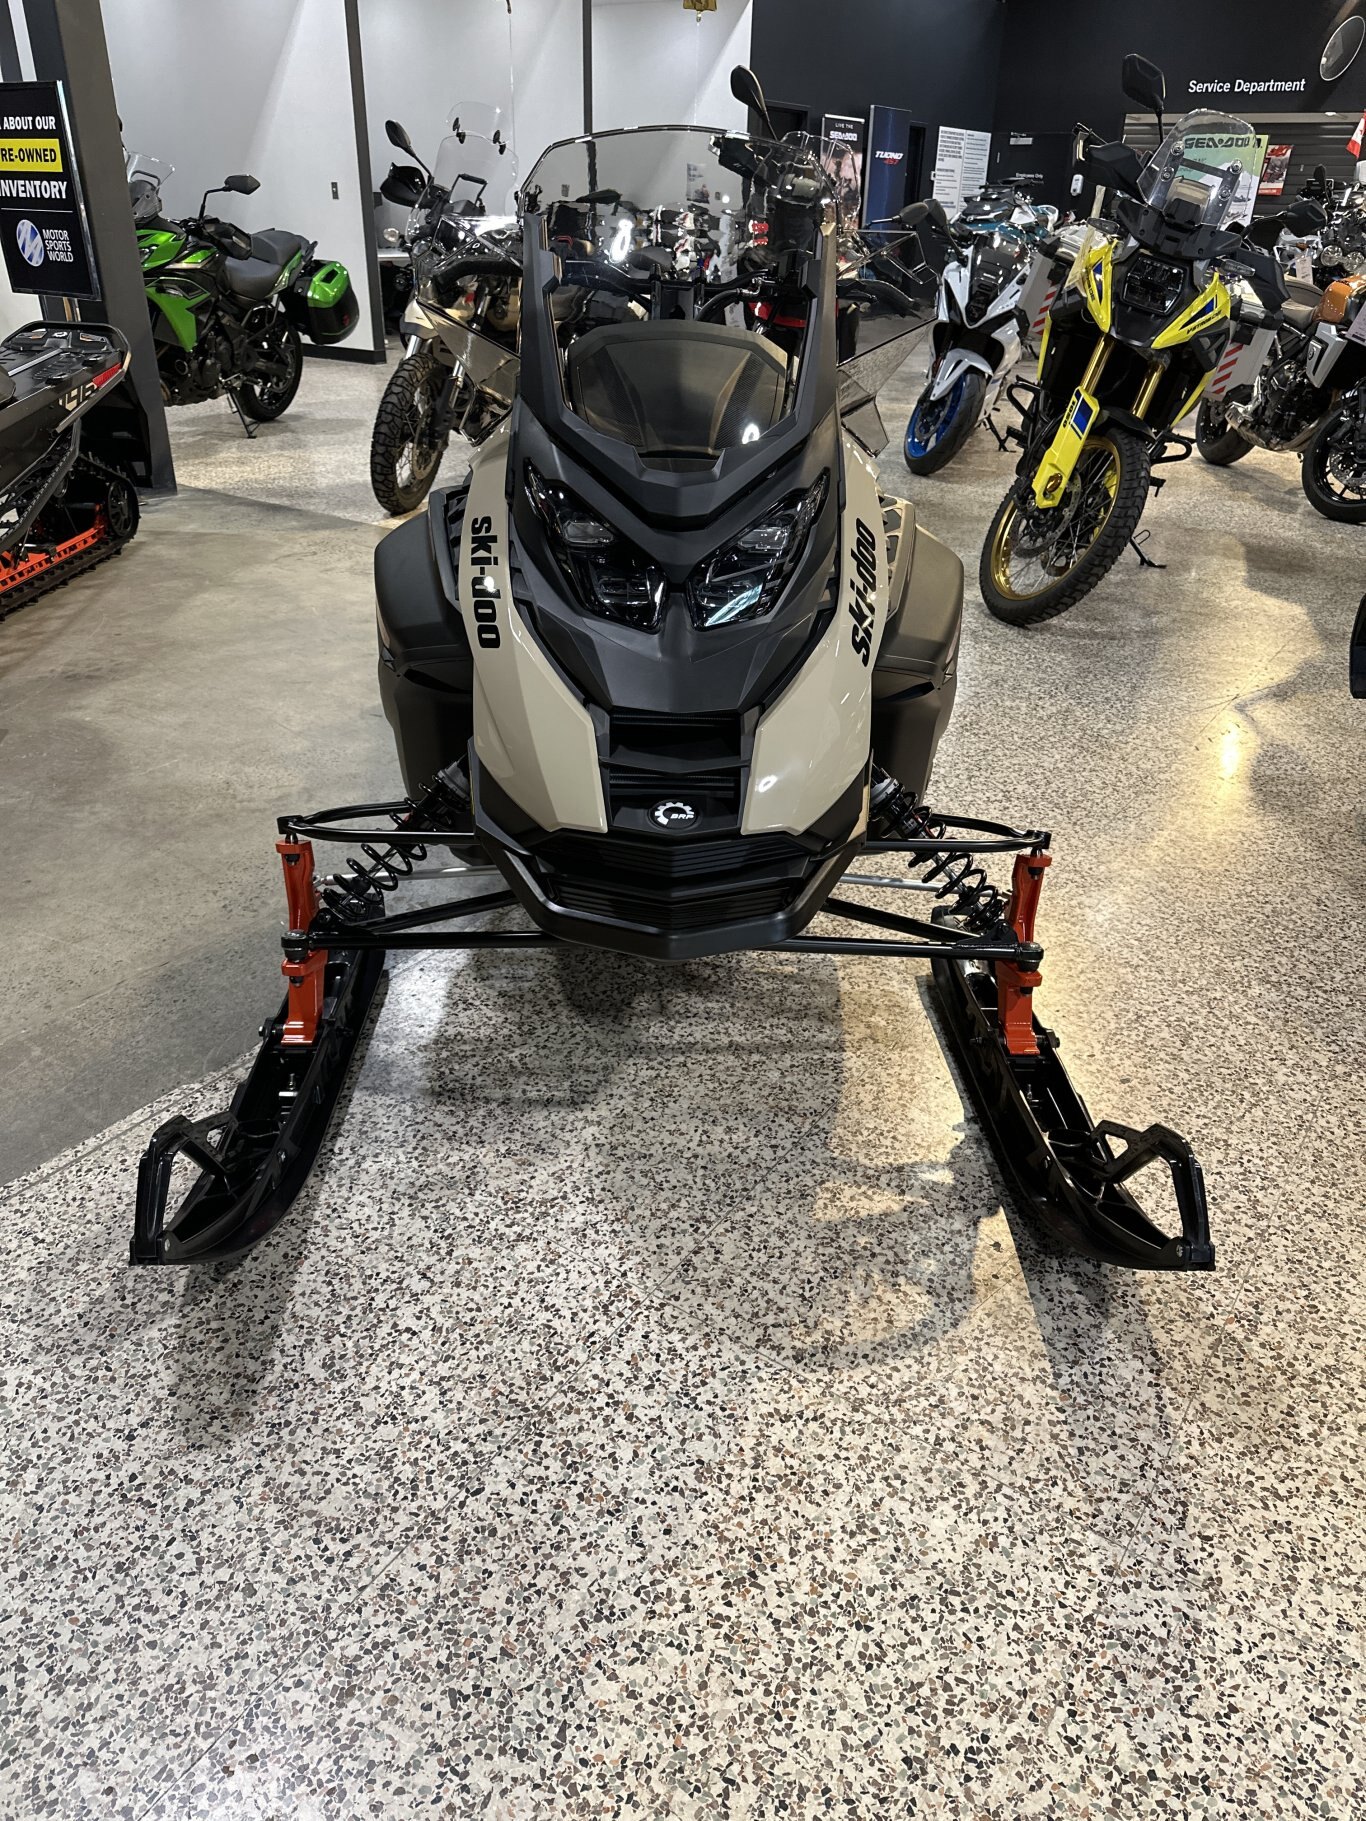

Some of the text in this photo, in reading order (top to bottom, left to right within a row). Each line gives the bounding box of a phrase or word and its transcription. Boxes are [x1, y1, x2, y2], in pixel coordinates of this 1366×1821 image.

[1188, 78, 1306, 95] Service Department
[3, 115, 56, 130] ABOUT OUR
[0, 147, 57, 163] RE-OWNED
[0, 179, 68, 199] NVENTORY
[42, 229, 70, 240] MOTOR
[45, 239, 71, 251] SPORTS
[47, 250, 74, 262] WORLD
[471, 515, 502, 650] ski-doo
[848, 517, 877, 668] ski-doo
